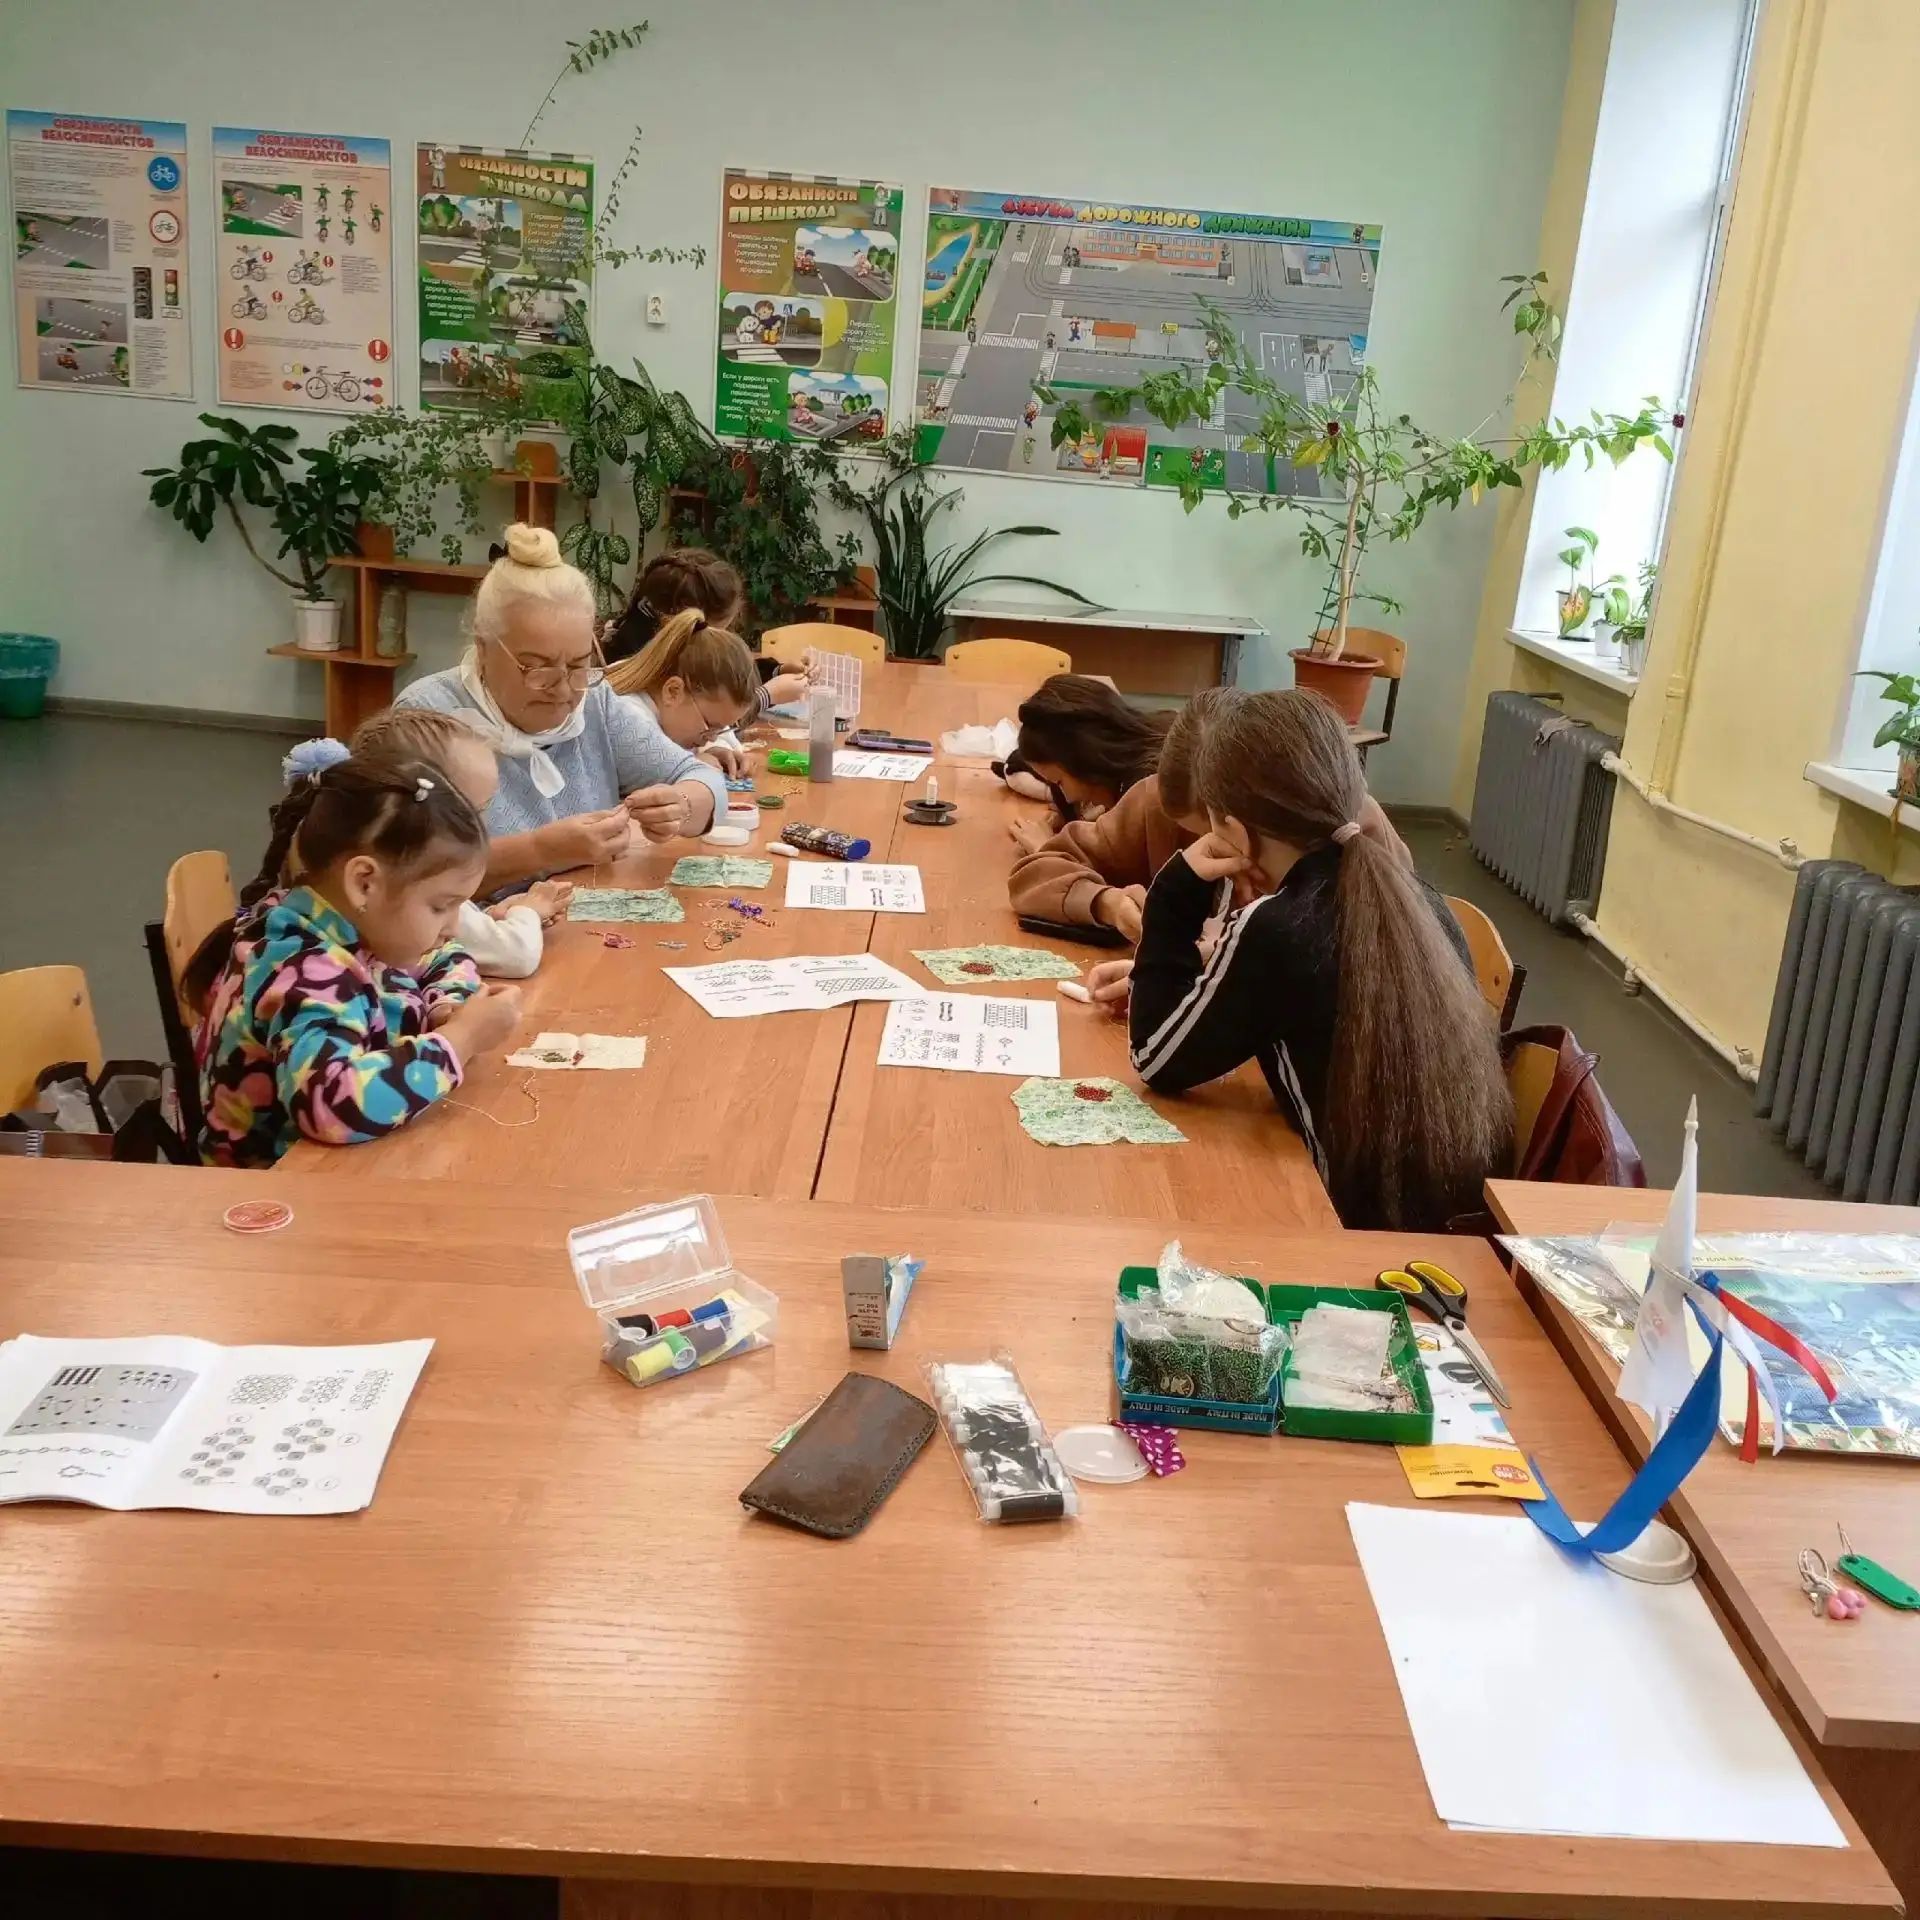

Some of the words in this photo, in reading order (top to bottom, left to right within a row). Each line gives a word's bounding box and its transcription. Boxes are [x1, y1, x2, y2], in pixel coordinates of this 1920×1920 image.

[729, 182, 858, 201] ОБЯЗАННОСТИ
[728, 205, 836, 223] ПЕШЕХОДА
[1077, 205, 1201, 229] ДОРОЖНОГО
[1129, 1401, 1152, 1411] ITALY
[1153, 1403, 1163, 1412] IN
[1164, 1404, 1190, 1414] MADE
[1206, 1408, 1230, 1418] ITALY
[1230, 1410, 1241, 1419] IN
[1242, 1411, 1268, 1422] MADE
